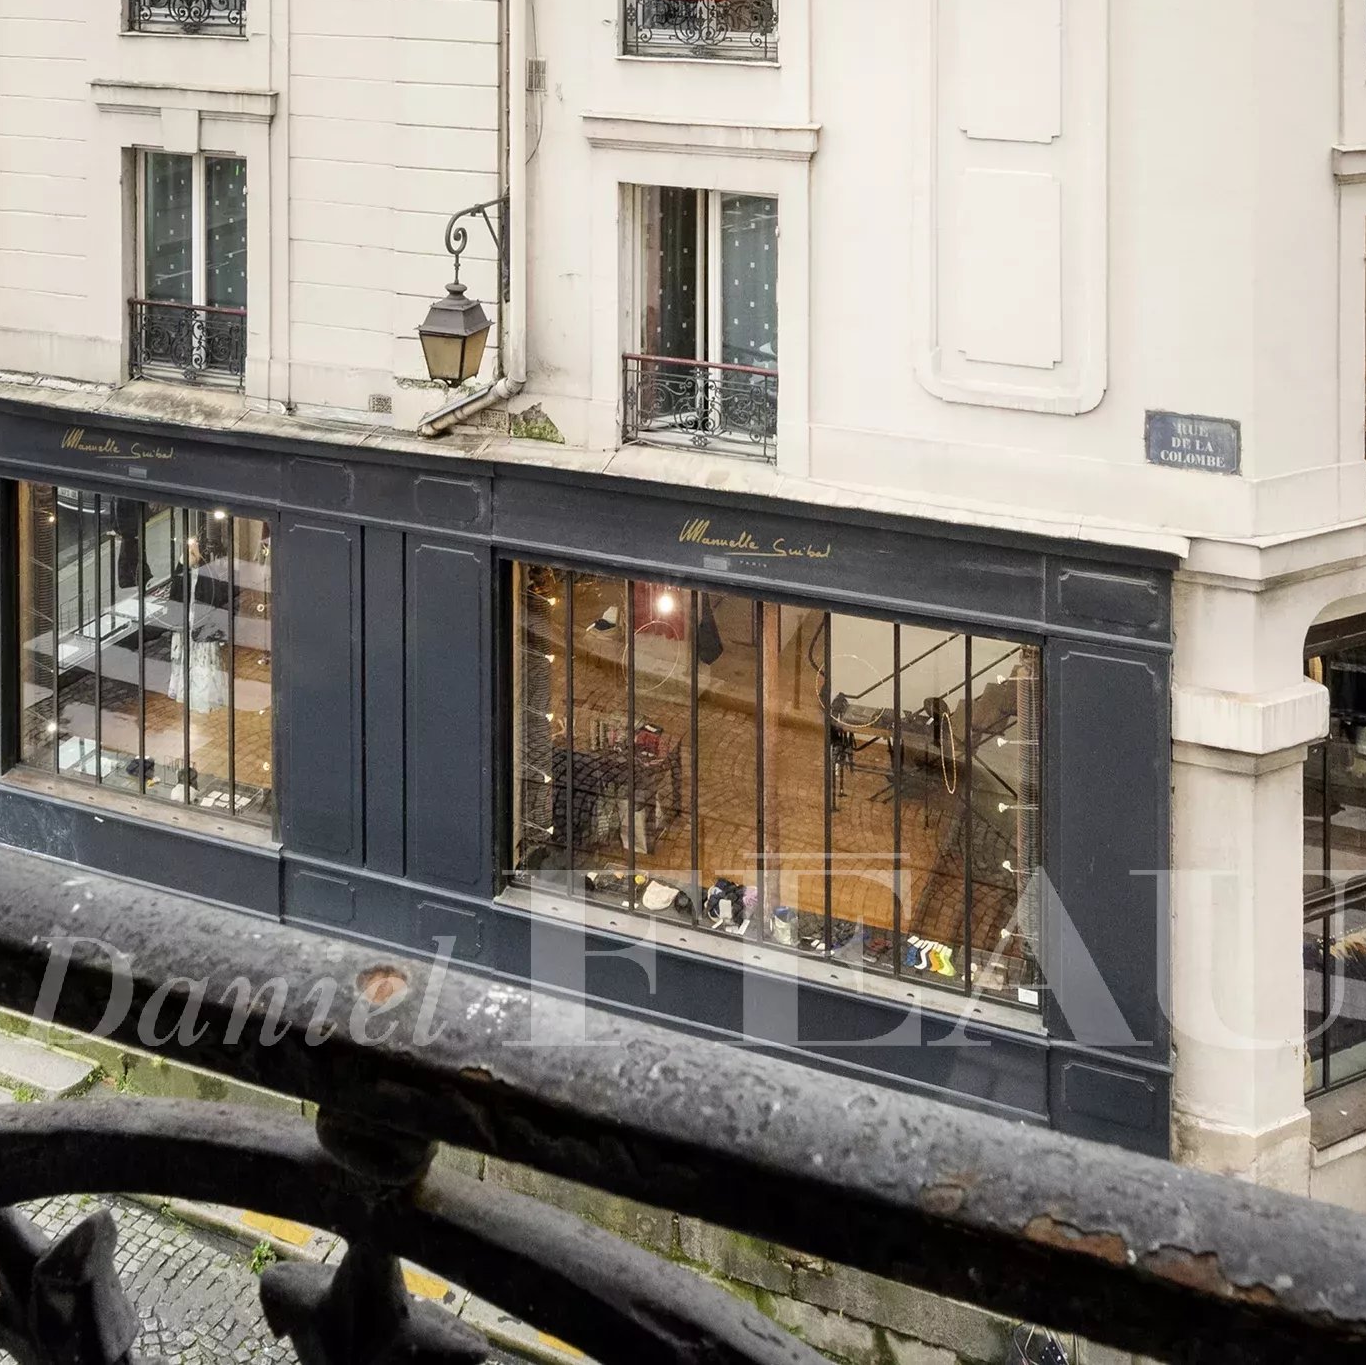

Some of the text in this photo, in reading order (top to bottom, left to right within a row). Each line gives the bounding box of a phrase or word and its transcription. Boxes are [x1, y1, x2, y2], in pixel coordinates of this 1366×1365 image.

[1176, 422, 1210, 438] RUE
[1171, 436, 1214, 452] DE LA
[1159, 449, 1226, 468] COLOMBE
